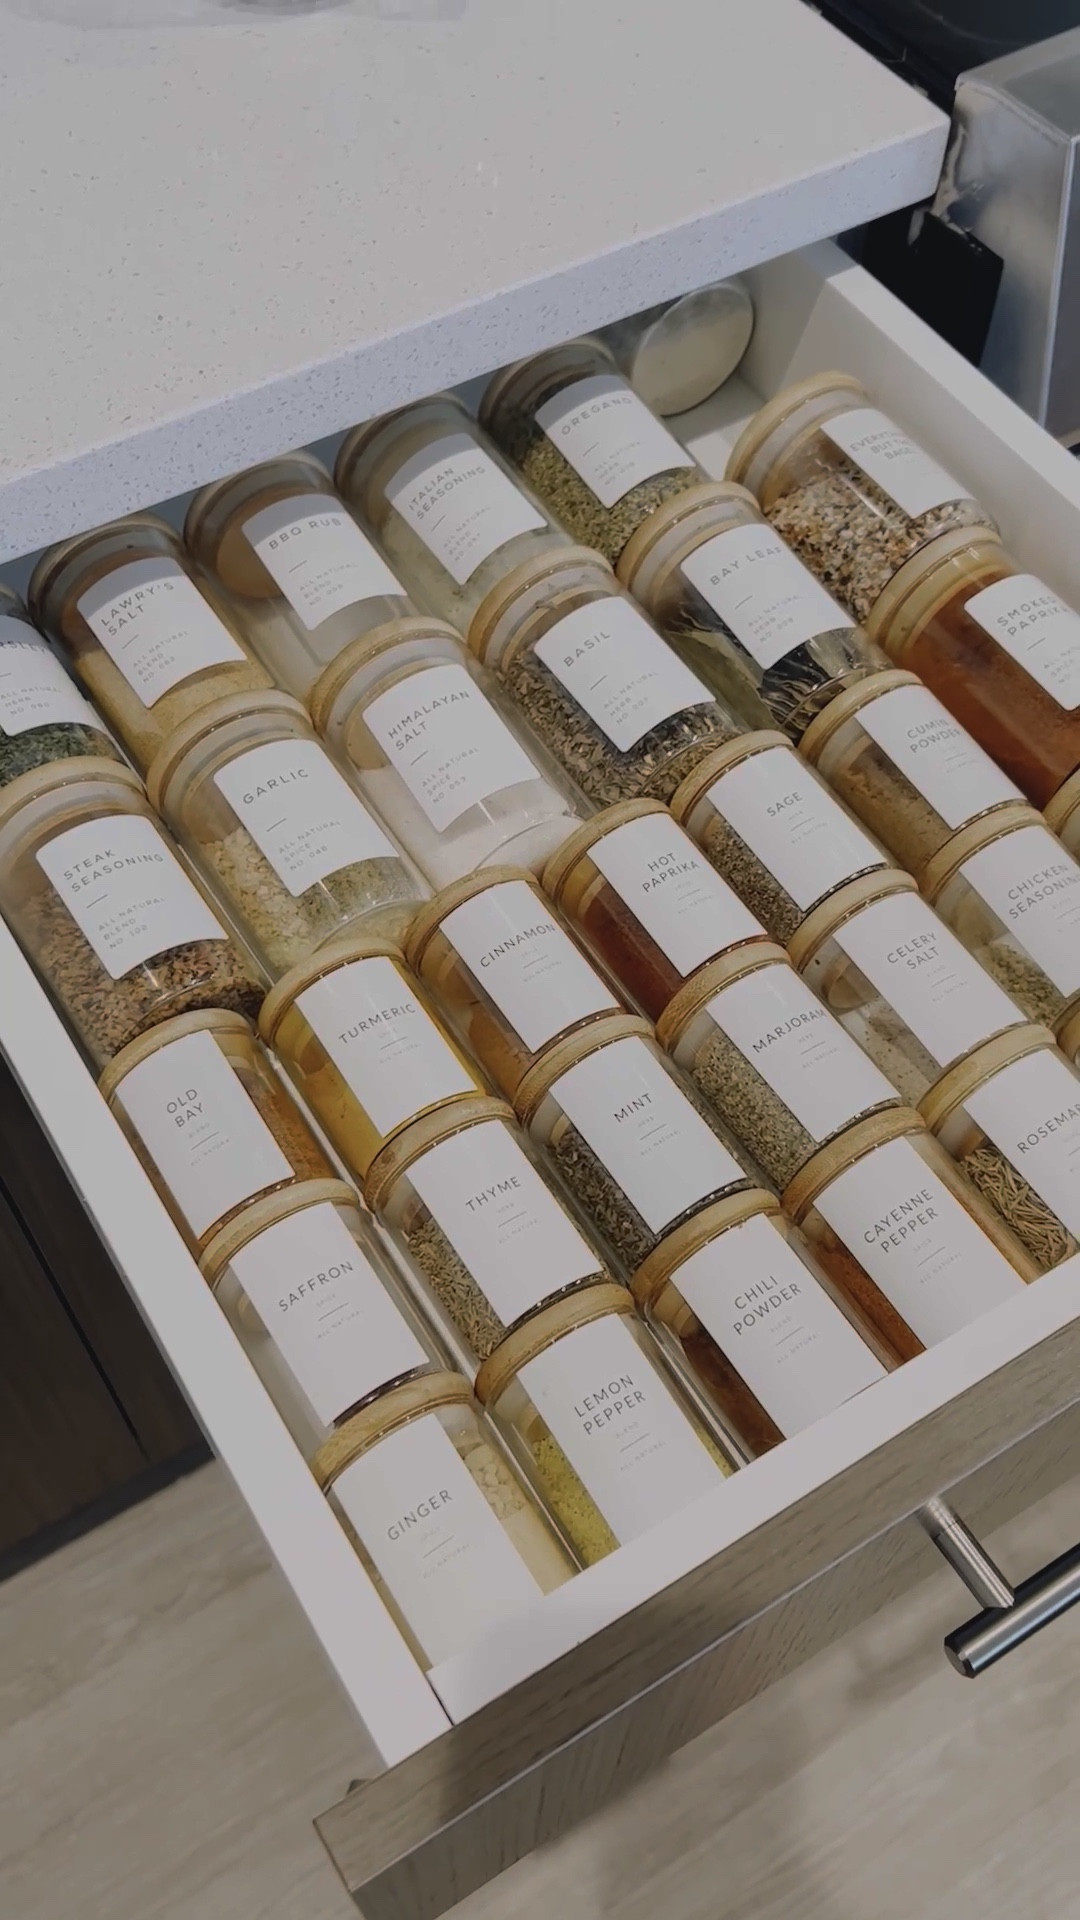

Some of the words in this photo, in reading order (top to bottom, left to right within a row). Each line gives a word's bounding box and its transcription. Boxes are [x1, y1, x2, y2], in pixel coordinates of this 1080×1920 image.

[560, 397, 632, 436] OREGANO
[408, 467, 455, 512] ITALIAN
[416, 465, 486, 520] SEASONING
[268, 526, 302, 551] BBQ
[308, 517, 343, 530] RUB
[710, 560, 740, 586] BAY
[100, 582, 175, 627] LAWRY'S
[107, 605, 145, 637] SALT
[563, 631, 612, 668] BASIL
[388, 690, 471, 740] HIMALAYAN
[395, 721, 429, 751] SALT
[242, 768, 310, 805] GARLIC
[766, 791, 803, 819] SAGE
[63, 849, 116, 881] STEAK
[71, 852, 165, 893] SEASONING
[641, 860, 702, 894] PAPRIKA
[647, 852, 677, 873] HOT
[1007, 863, 1069, 901] CHICKEN
[480, 923, 556, 969] CINNAMON
[886, 931, 937, 965] CELERY
[906, 946, 941, 971] SALT
[338, 1003, 416, 1046] TURMERIC
[752, 1008, 826, 1054] MARJORAM
[166, 1088, 199, 1115] OLD
[174, 1101, 204, 1129] BAY
[613, 1092, 653, 1124] MINT
[464, 1175, 521, 1212] THYME
[863, 1188, 934, 1245] CAYENNE
[880, 1207, 939, 1254] PEPPER
[278, 1260, 354, 1312] SAFFRON
[734, 1275, 779, 1311] CHILI
[733, 1282, 802, 1336] POWDER
[573, 1374, 635, 1419] LEMON
[582, 1390, 647, 1436] PEPPER
[387, 1488, 454, 1541] GINGER
